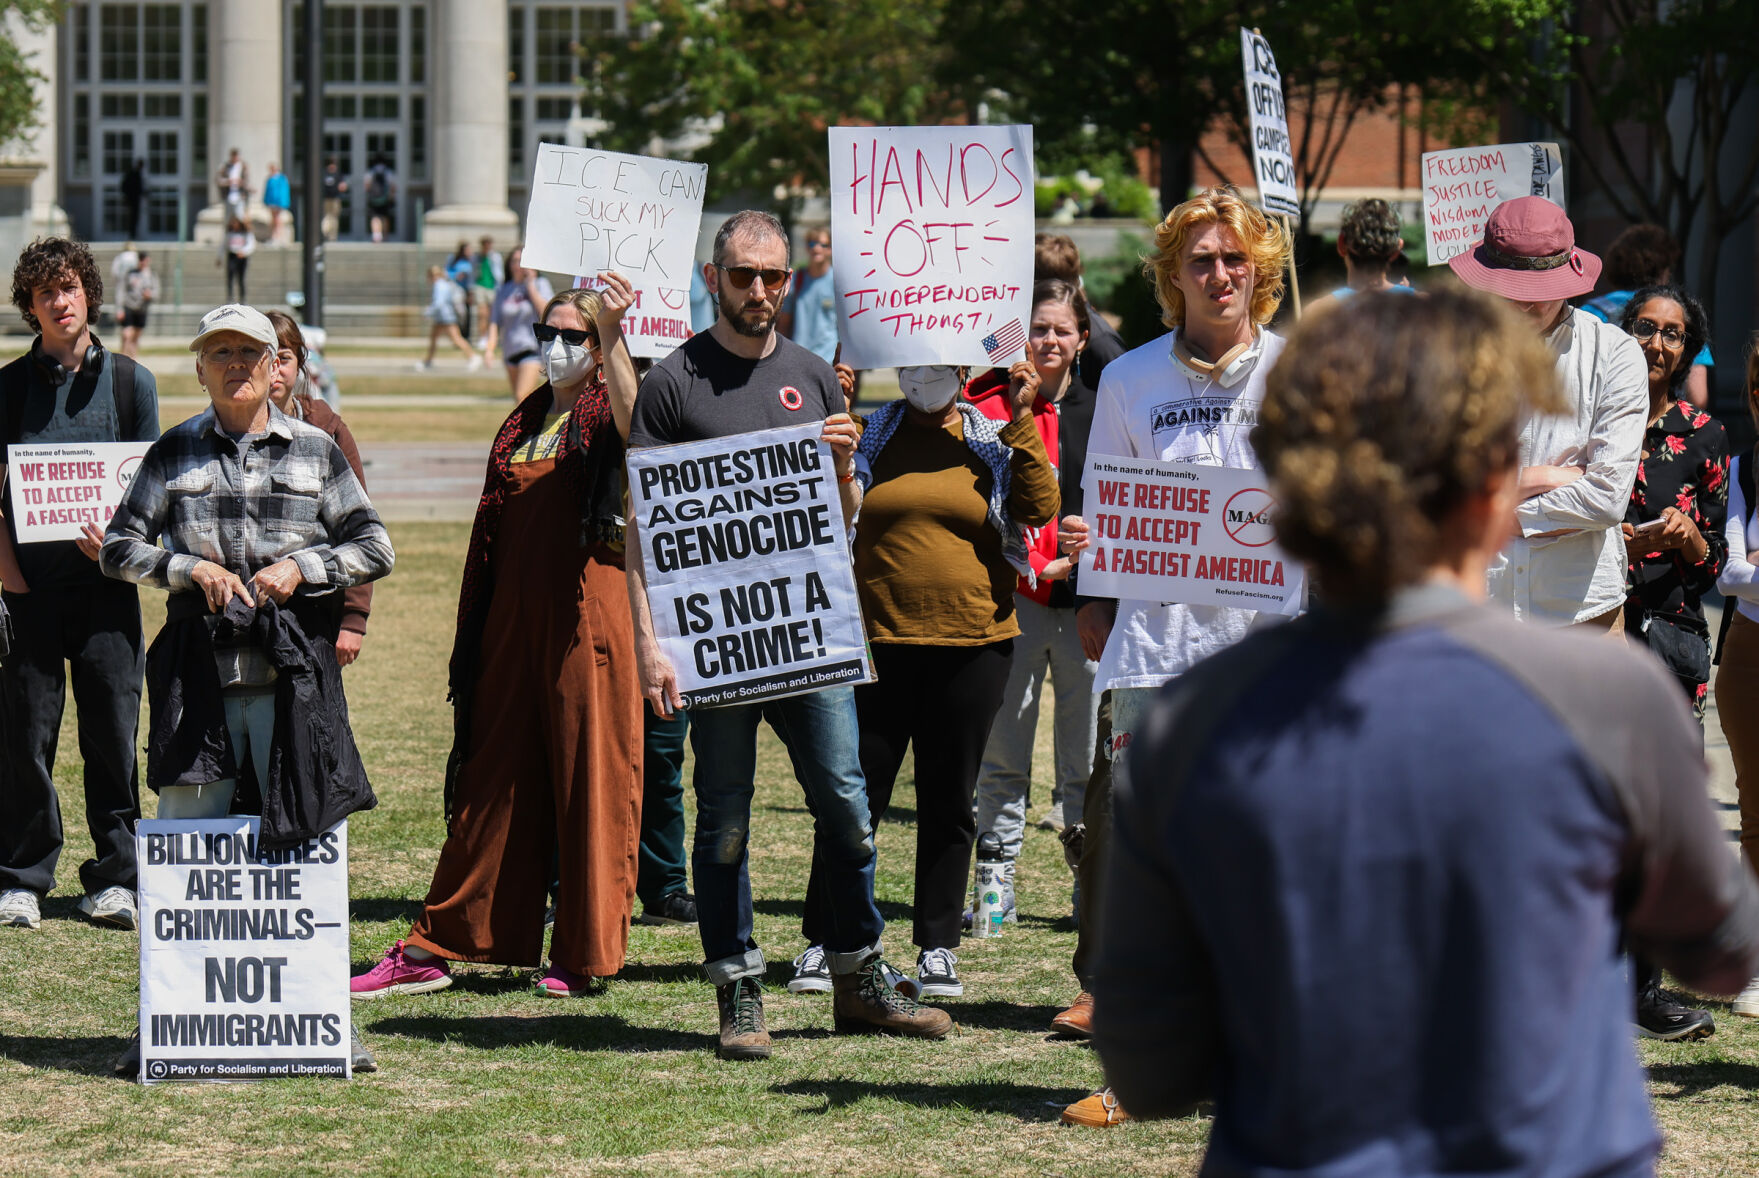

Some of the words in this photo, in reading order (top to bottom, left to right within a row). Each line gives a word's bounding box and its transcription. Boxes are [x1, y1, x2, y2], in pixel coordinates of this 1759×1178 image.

[1426, 151, 1506, 178] FREEDOM
[659, 169, 702, 200] CAN
[850, 138, 1022, 226] HANDS
[1428, 179, 1498, 207] JUSTICE
[576, 196, 630, 224] SUCK
[639, 202, 674, 229] MY
[884, 219, 974, 277] OFF
[1433, 223, 1486, 244] MODER
[580, 223, 669, 279] PICK
[844, 284, 1020, 319] INDEPENDENT
[1154, 406, 1233, 431] AGAINST
[62, 449, 95, 457] humanity,
[639, 438, 821, 500] PROTESTING
[20, 463, 45, 481] WE
[48, 461, 106, 481] REFUSE
[1094, 463, 1102, 471] In
[1104, 464, 1118, 473] the
[1120, 466, 1143, 475] name
[1145, 467, 1154, 476] of
[1156, 468, 1200, 481] humanity,
[22, 487, 43, 505] TO
[47, 485, 102, 504] ACCEPT
[648, 477, 824, 528] AGAINST
[1098, 480, 1130, 506] WE
[1134, 483, 1211, 514] REFUSE
[26, 511, 37, 527] A
[40, 507, 100, 526] FASCIST
[1096, 513, 1121, 539] TO
[1125, 516, 1201, 546] ACCEPT
[652, 504, 834, 573] GENOCIDE
[1093, 547, 1107, 572] A
[1111, 548, 1191, 577] FASCIST
[1194, 555, 1285, 587] AMERICA
[674, 593, 713, 637] IS
[720, 577, 791, 628] NOT
[805, 571, 831, 613] A
[1215, 588, 1284, 602] RefuseFascism.org
[693, 618, 827, 679] CRIME!
[695, 692, 720, 706] Party
[723, 688, 737, 700] for
[739, 679, 787, 696] Socialism
[789, 674, 808, 687] and
[810, 665, 860, 683] Liberation
[185, 869, 242, 900] ARE
[248, 869, 302, 900] THE
[205, 956, 287, 1003] NOT
[151, 1013, 341, 1047] IMMIGRANTS
[170, 1064, 198, 1075] Party
[200, 1064, 215, 1074] for
[217, 1064, 267, 1074] Socialism
[269, 1064, 289, 1074] and
[291, 1063, 343, 1074] Liberation
